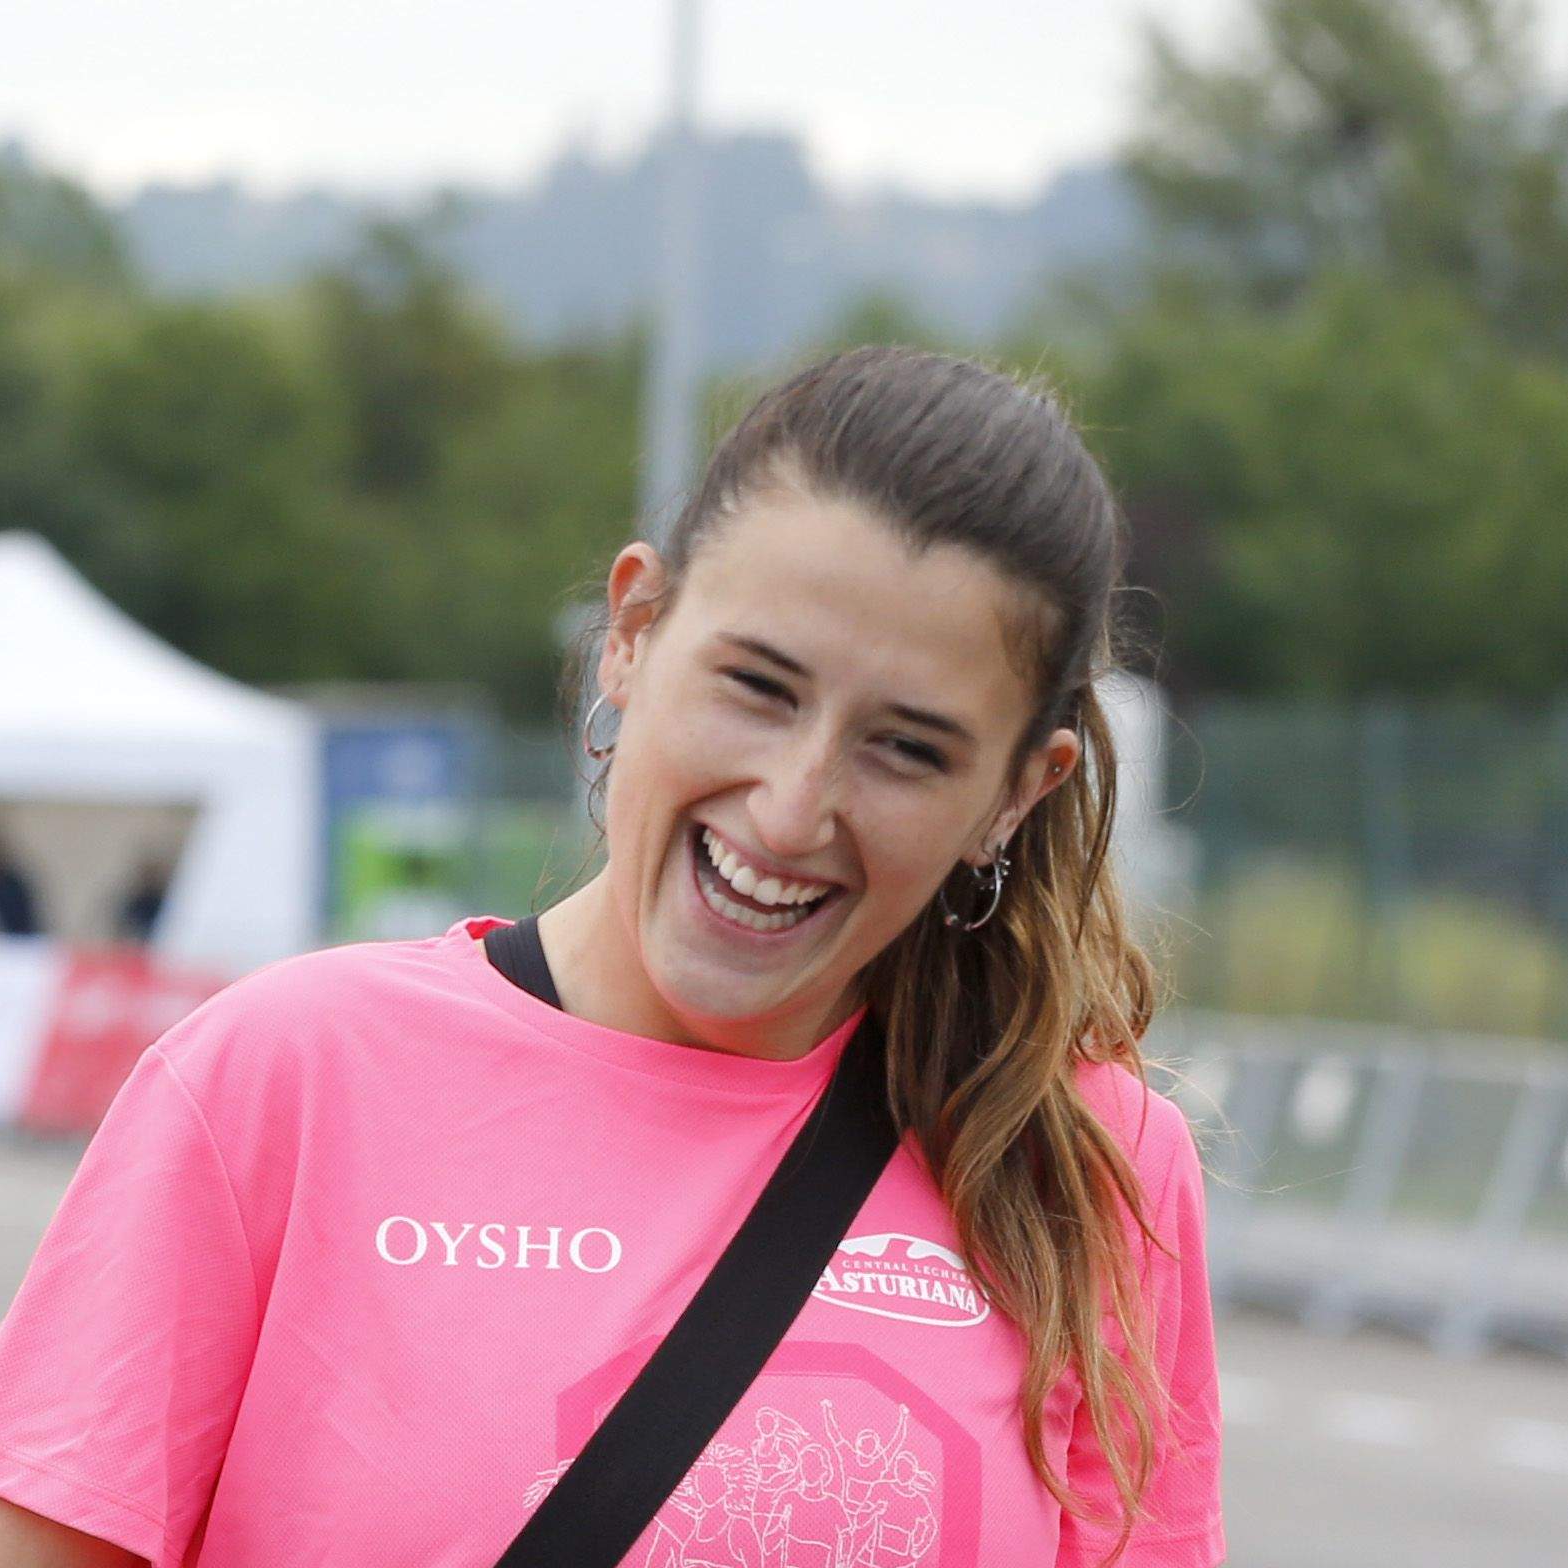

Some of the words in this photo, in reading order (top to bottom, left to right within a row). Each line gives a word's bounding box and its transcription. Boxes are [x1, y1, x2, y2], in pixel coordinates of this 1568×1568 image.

[375, 1216, 622, 1272] OYSHO
[814, 1265, 979, 1315] ASTURIANA
[842, 1260, 908, 1272] CENTRAL
[914, 1266, 971, 1284] LECHER
